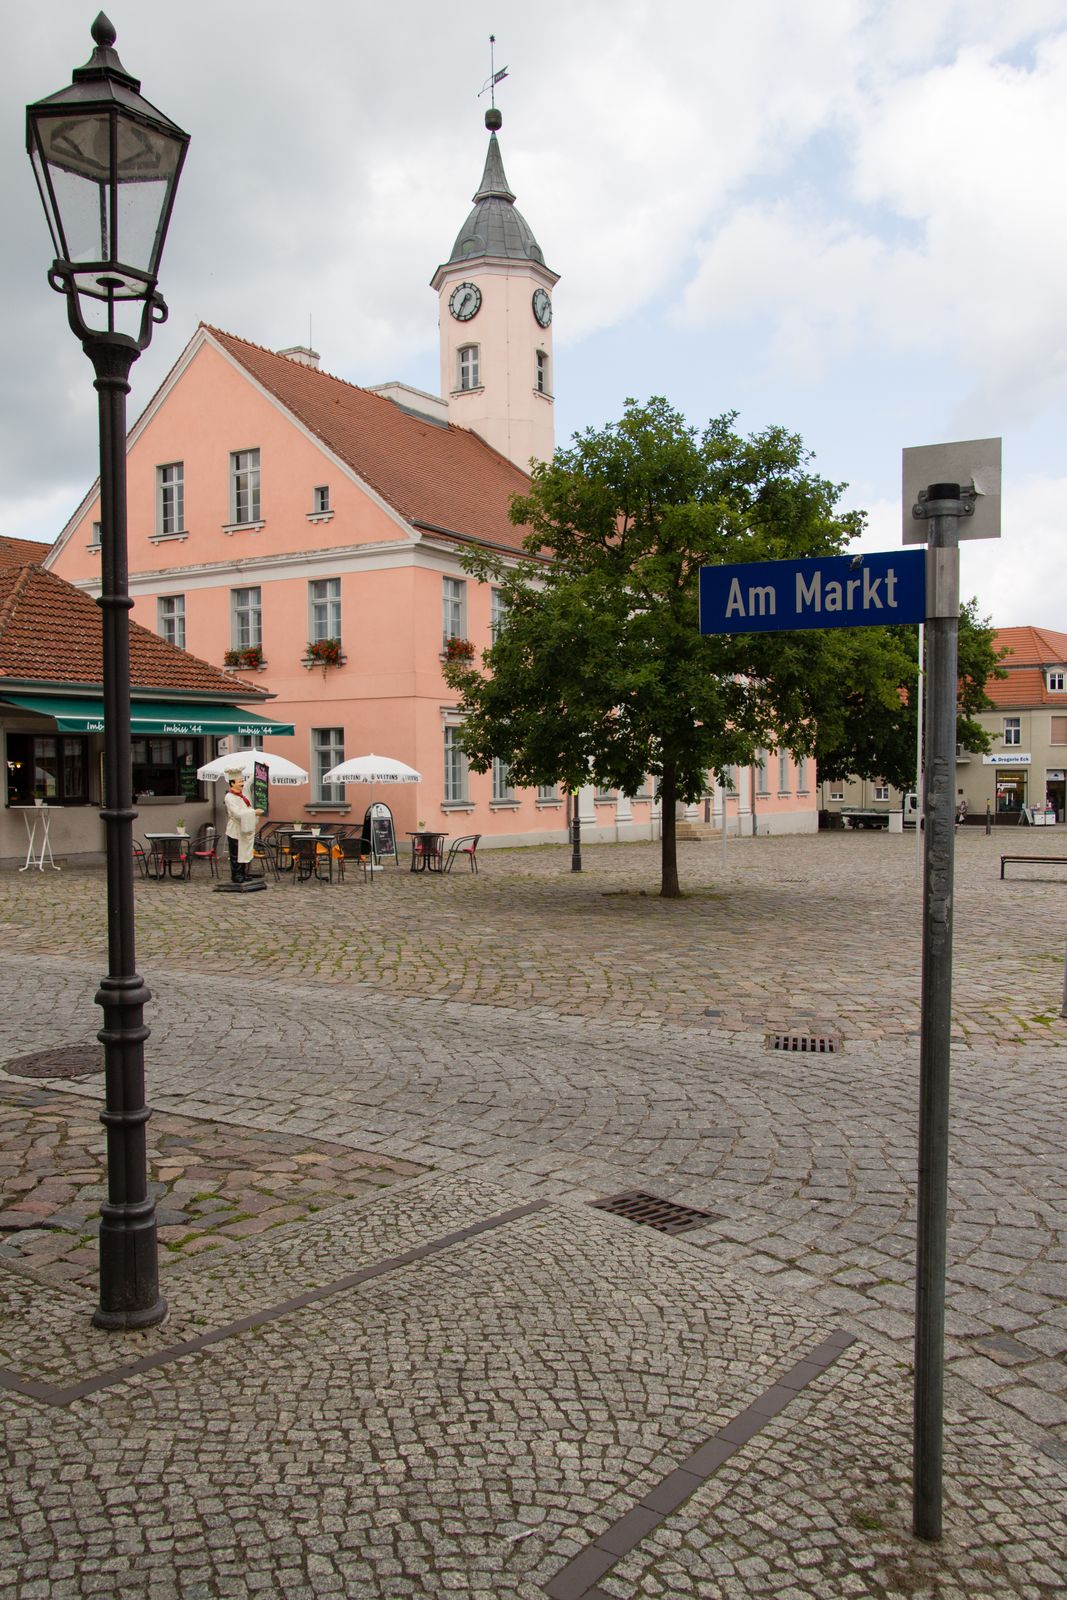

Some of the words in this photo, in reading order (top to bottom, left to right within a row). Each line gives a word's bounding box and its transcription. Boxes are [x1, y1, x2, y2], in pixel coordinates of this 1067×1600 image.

[725, 578, 777, 618] Am
[795, 567, 898, 614] Markt
[163, 724, 189, 733] Imbiss
[238, 726, 260, 734] Imbiss
[277, 777, 298, 785] VELTINS
